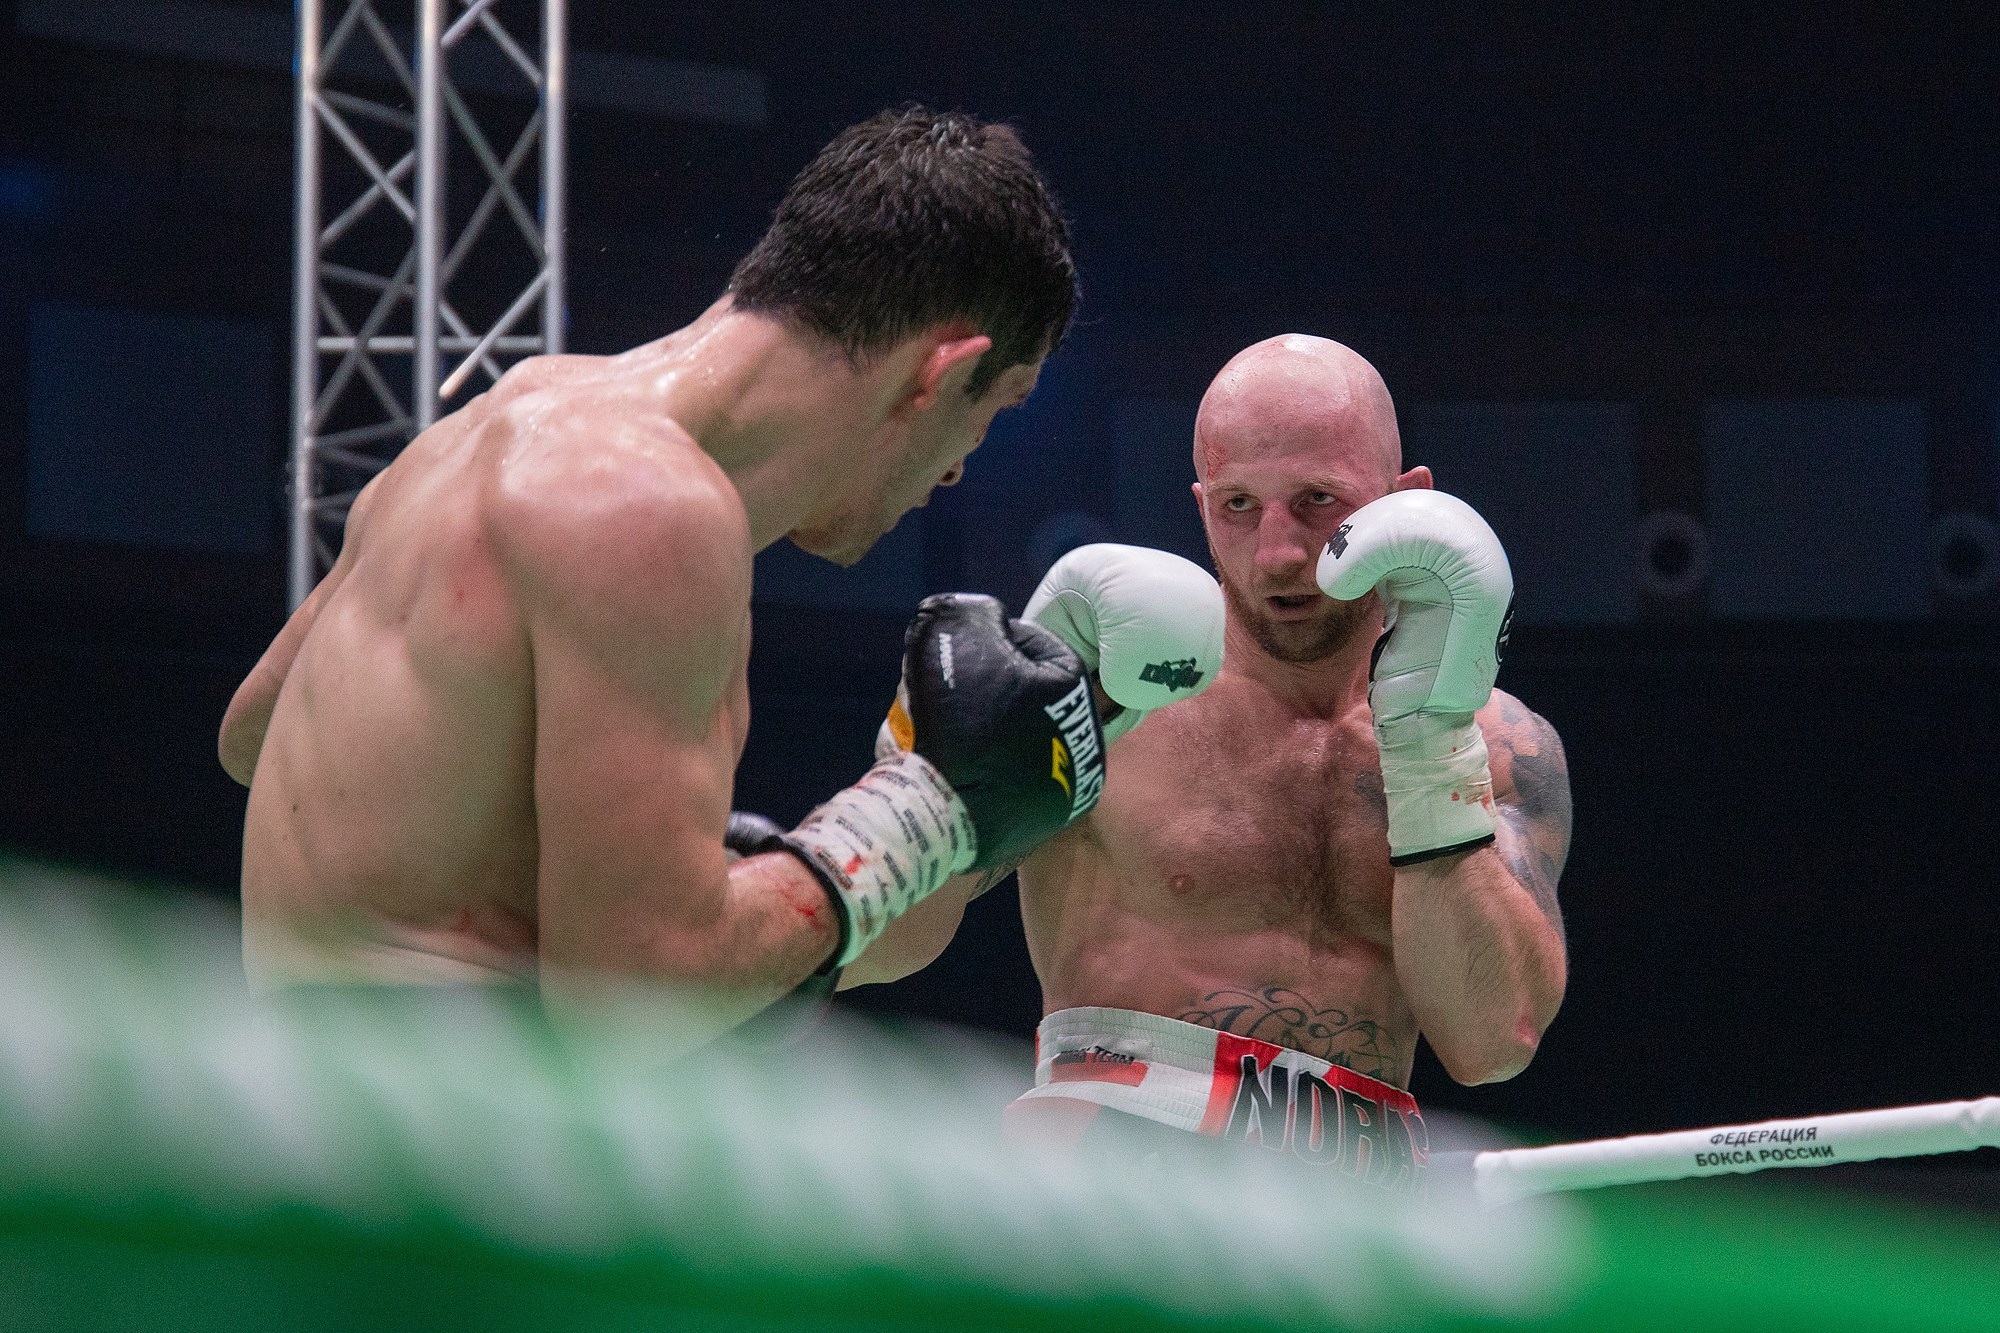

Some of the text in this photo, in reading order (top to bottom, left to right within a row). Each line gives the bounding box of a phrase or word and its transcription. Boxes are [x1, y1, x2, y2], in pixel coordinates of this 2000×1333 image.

[1092, 1045, 1135, 1066] TEAM
[1710, 1126, 1818, 1148] ФЕДЕРАЦИЯ
[1695, 1145, 1835, 1167] БОКСА РОССИИ
